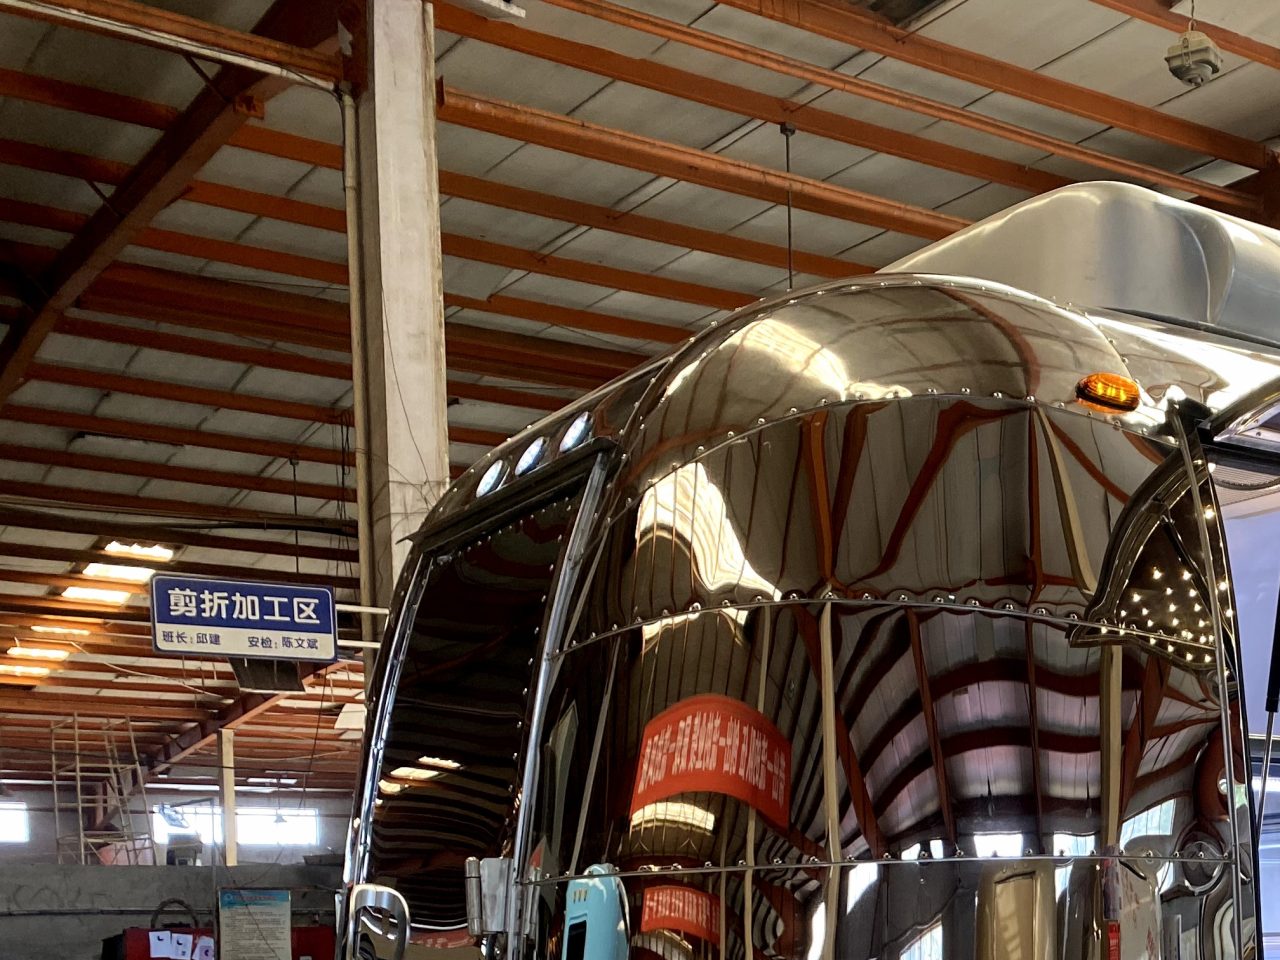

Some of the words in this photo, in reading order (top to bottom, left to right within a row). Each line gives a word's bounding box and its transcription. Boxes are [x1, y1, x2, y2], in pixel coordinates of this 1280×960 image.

[167, 587, 320, 624] 剪折加工区
